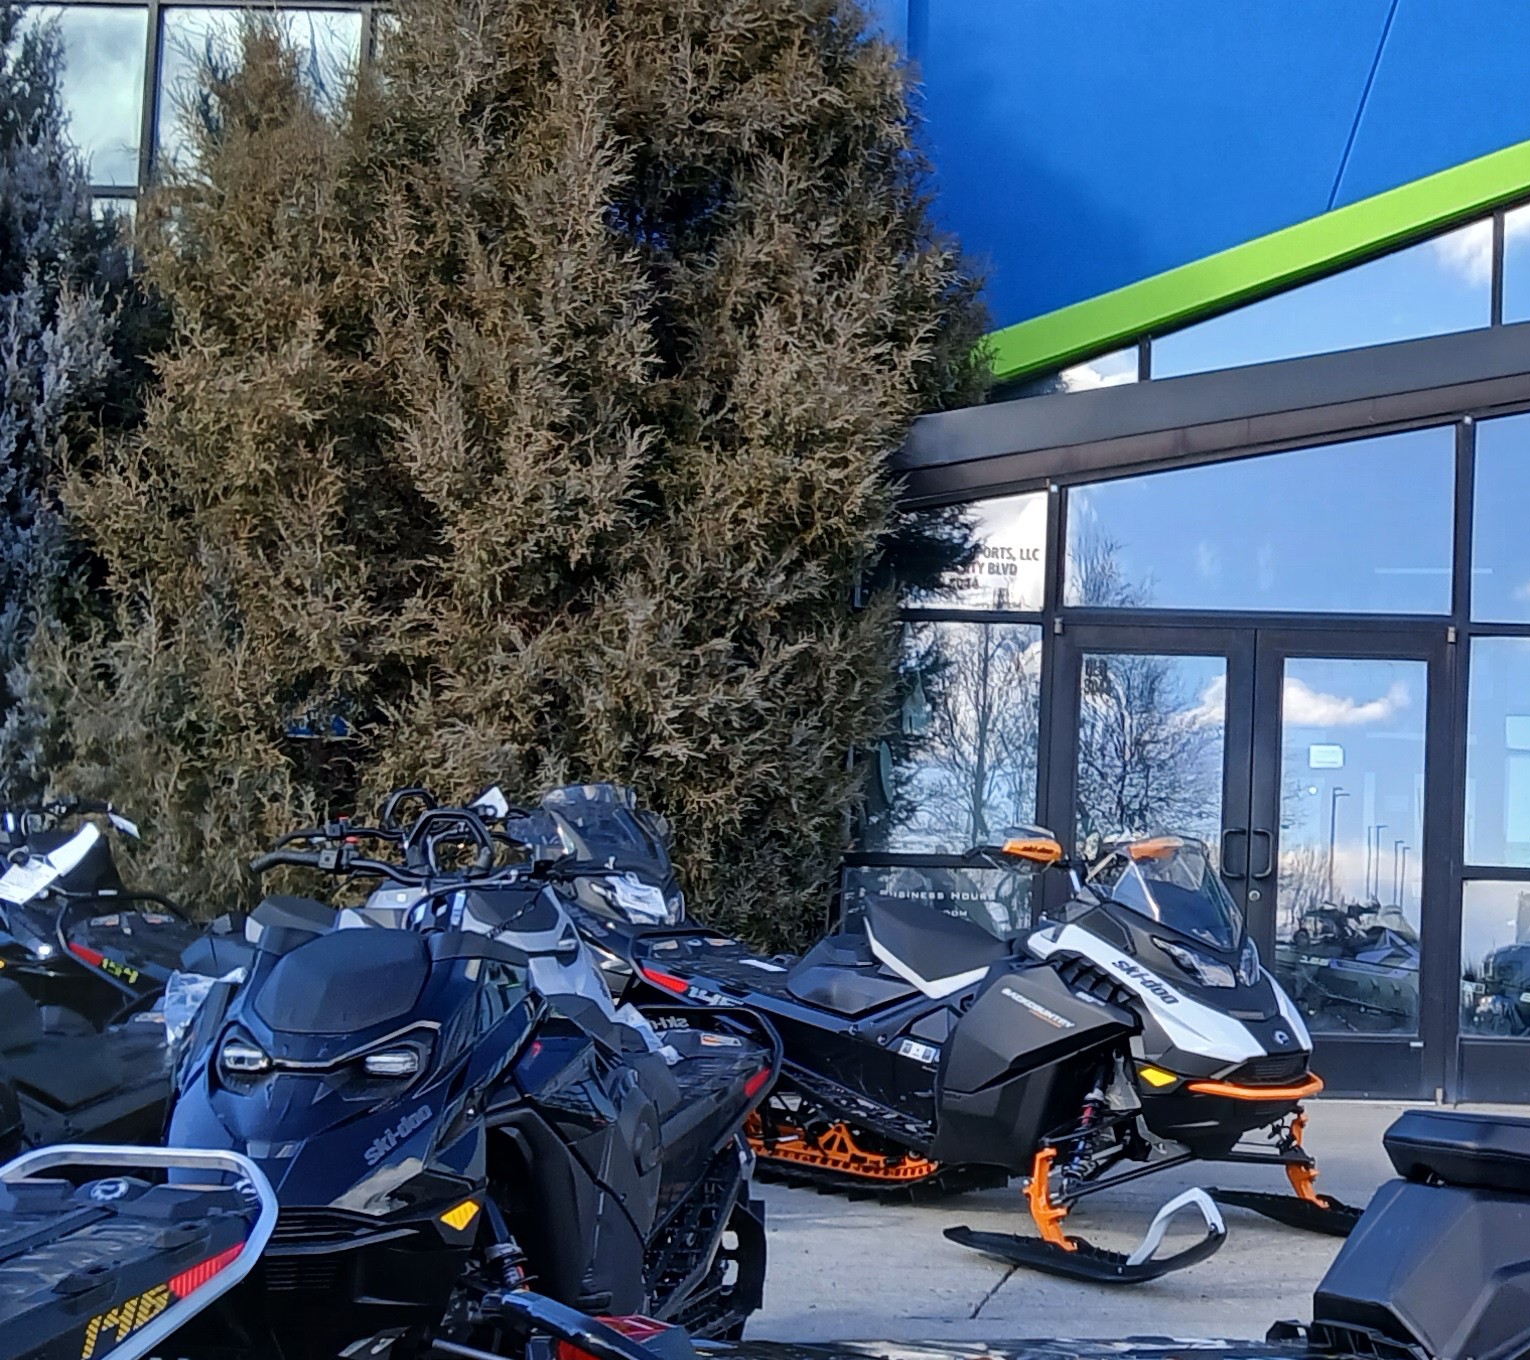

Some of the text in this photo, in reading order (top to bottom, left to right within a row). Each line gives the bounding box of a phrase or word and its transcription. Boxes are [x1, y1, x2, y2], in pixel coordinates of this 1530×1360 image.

[987, 562, 1018, 576] BLVD
[1019, 547, 1040, 561] LLC
[1111, 959, 1180, 1005] ski-doo
[1001, 987, 1076, 1029] BACKCOUNTRY
[363, 1104, 433, 1166] ski-doo
